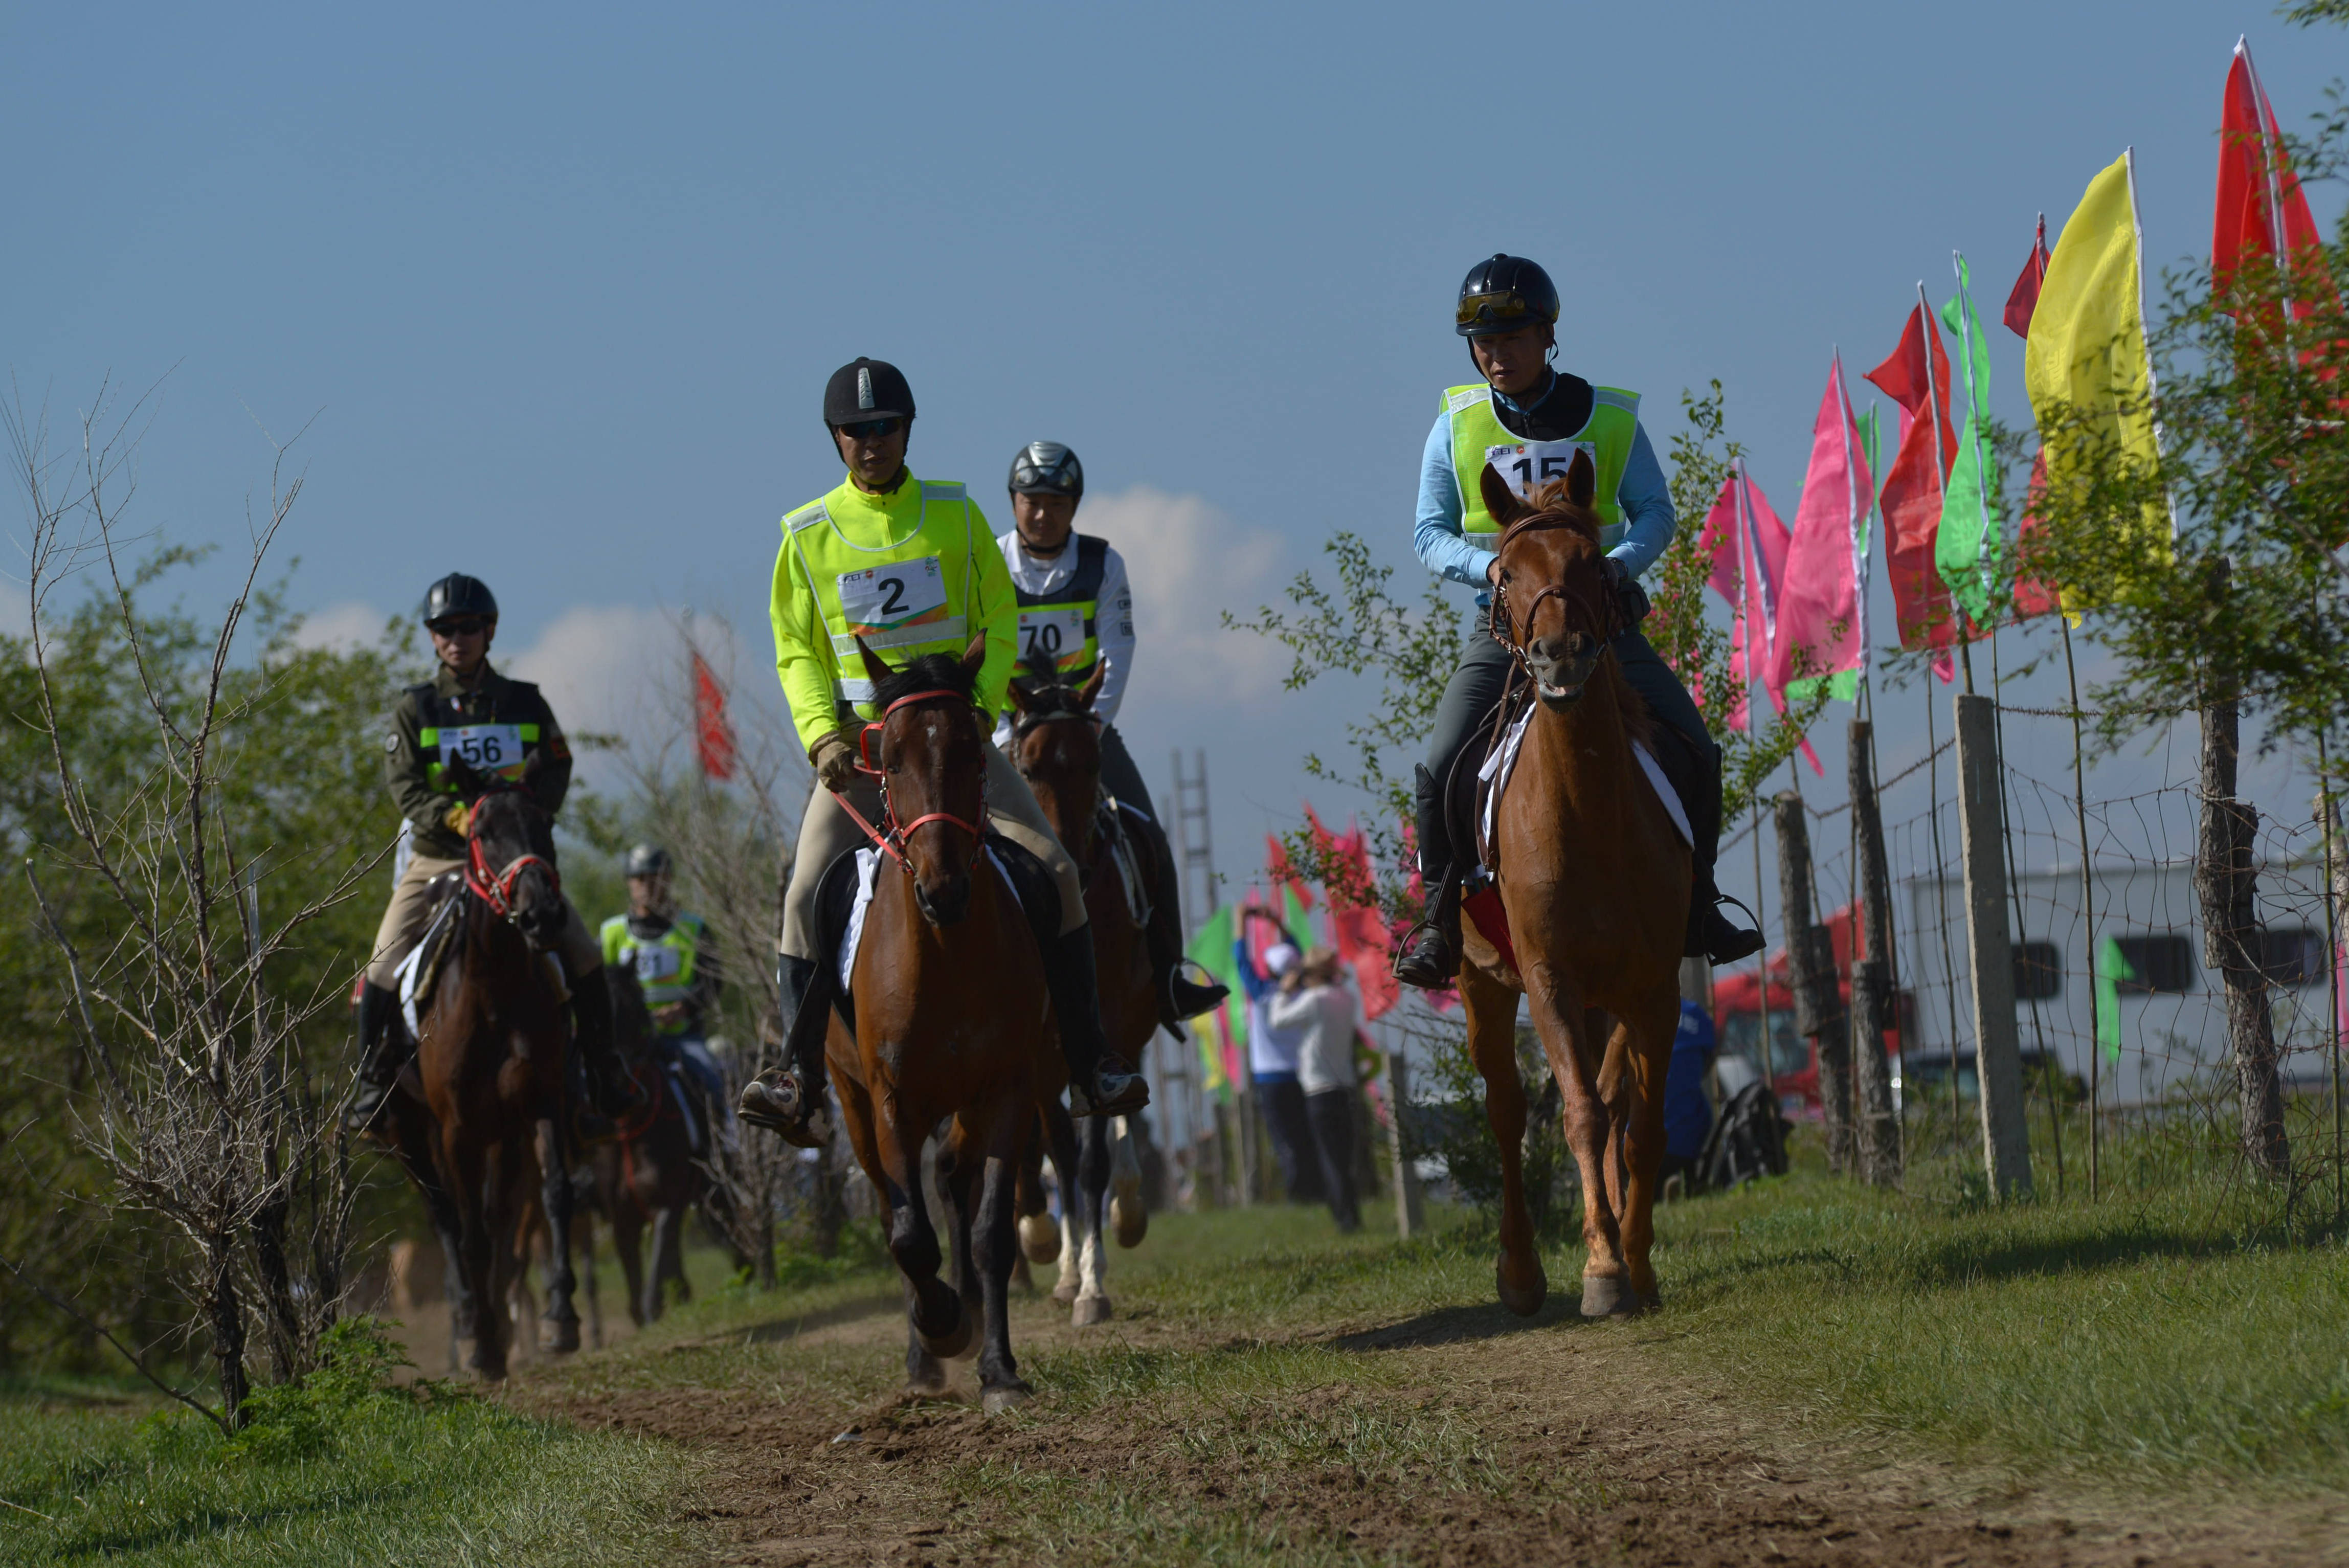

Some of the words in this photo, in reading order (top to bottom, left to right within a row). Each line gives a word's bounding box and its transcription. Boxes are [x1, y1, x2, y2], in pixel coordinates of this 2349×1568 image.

[1513, 457, 1567, 495] 15
[878, 578, 909, 615] 2
[1020, 623, 1062, 656] 70
[462, 735, 502, 764] 56
